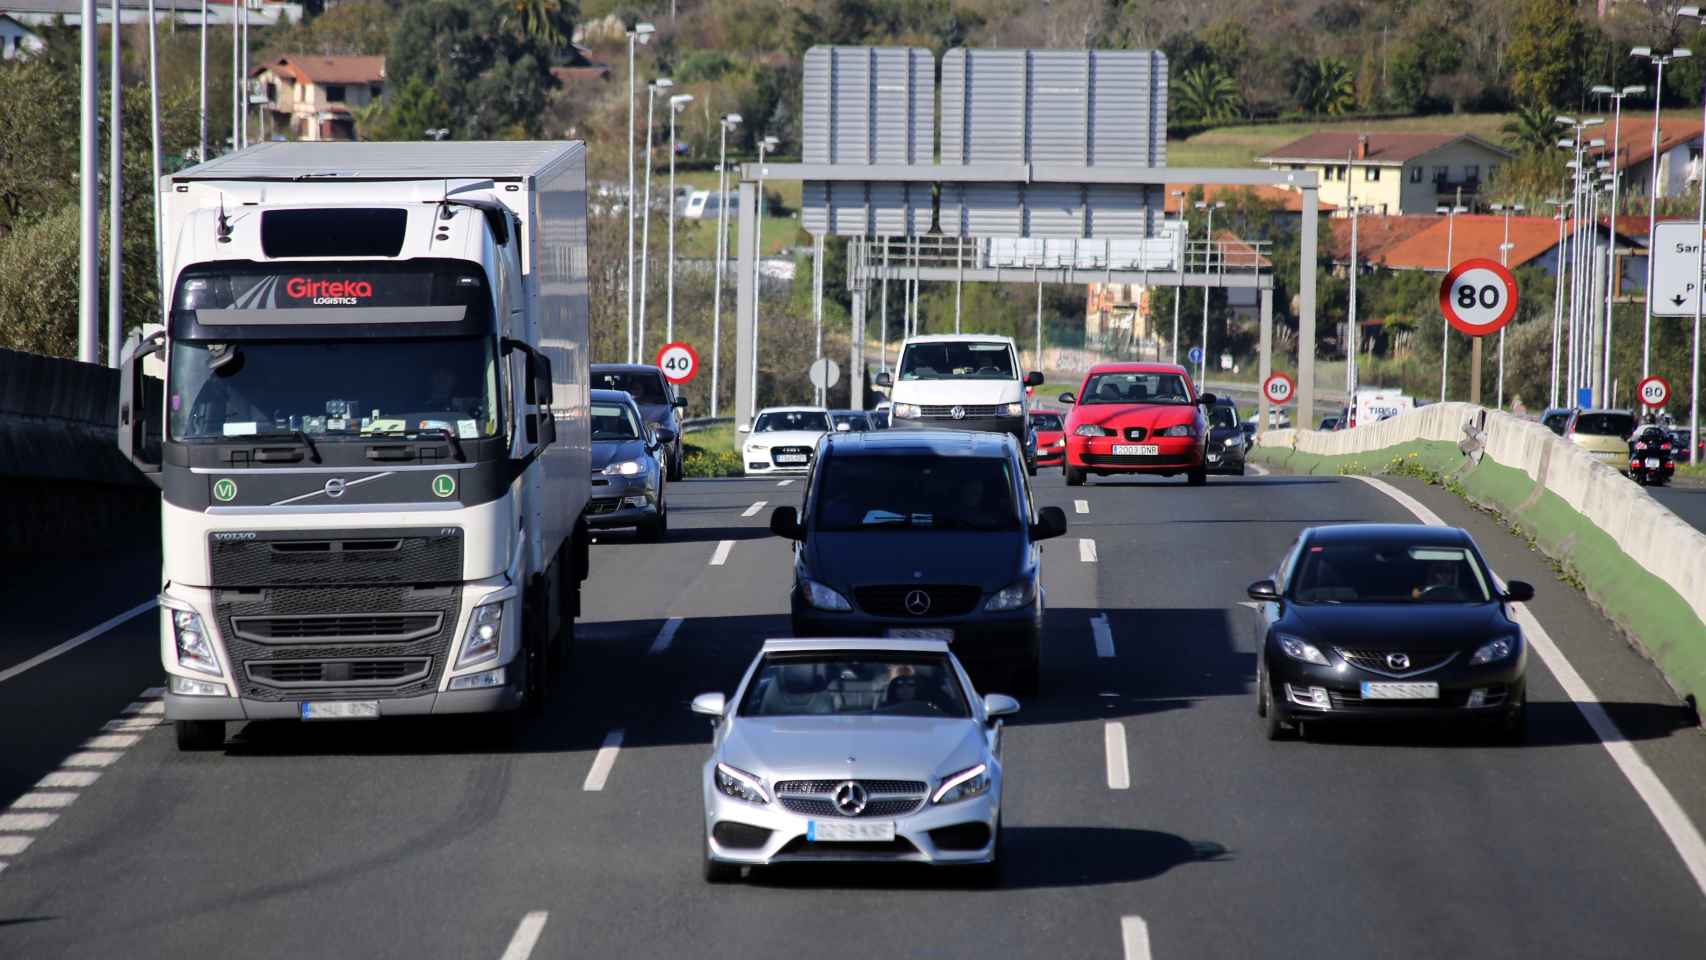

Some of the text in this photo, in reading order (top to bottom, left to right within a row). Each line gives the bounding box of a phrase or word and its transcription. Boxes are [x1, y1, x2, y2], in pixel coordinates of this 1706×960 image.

[287, 277, 372, 298] Girteka
[313, 297, 357, 305] LOGISTICS
[1458, 285, 1499, 309] 80
[665, 357, 689, 370] 40
[1271, 384, 1287, 393] 80
[1645, 387, 1663, 397] 80
[218, 484, 232, 497] VI
[439, 479, 449, 493] L
[214, 532, 256, 540] VOLVO
